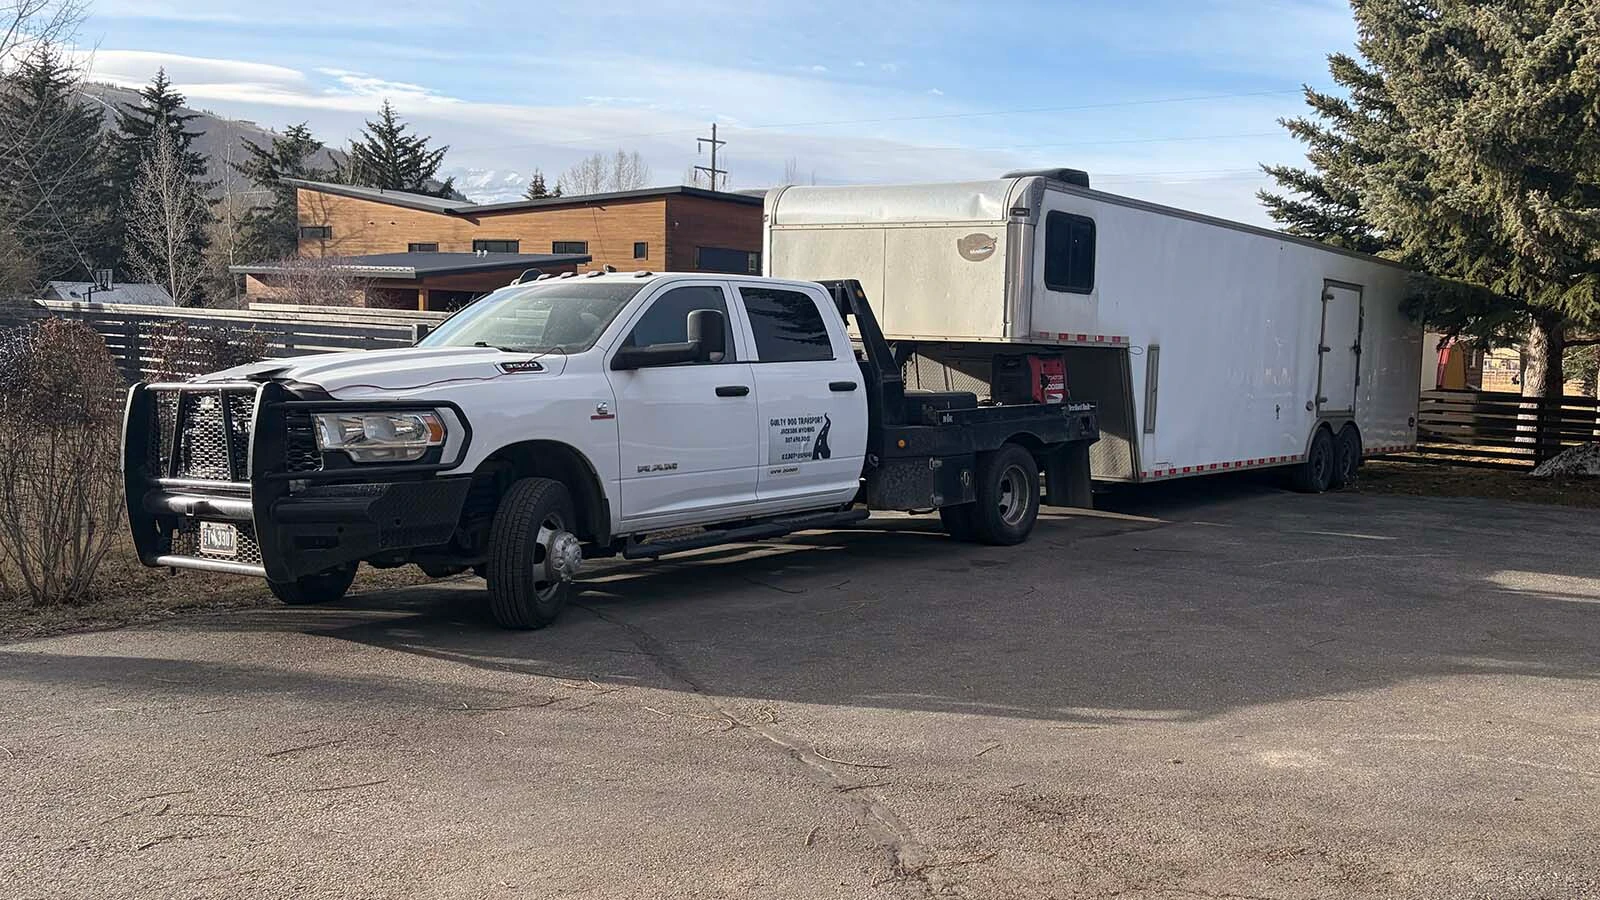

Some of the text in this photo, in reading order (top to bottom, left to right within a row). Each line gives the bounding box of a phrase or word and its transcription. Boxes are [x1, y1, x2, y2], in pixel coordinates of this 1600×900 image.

[770, 416, 823, 426] GUILTY DOG TRANSPORT
